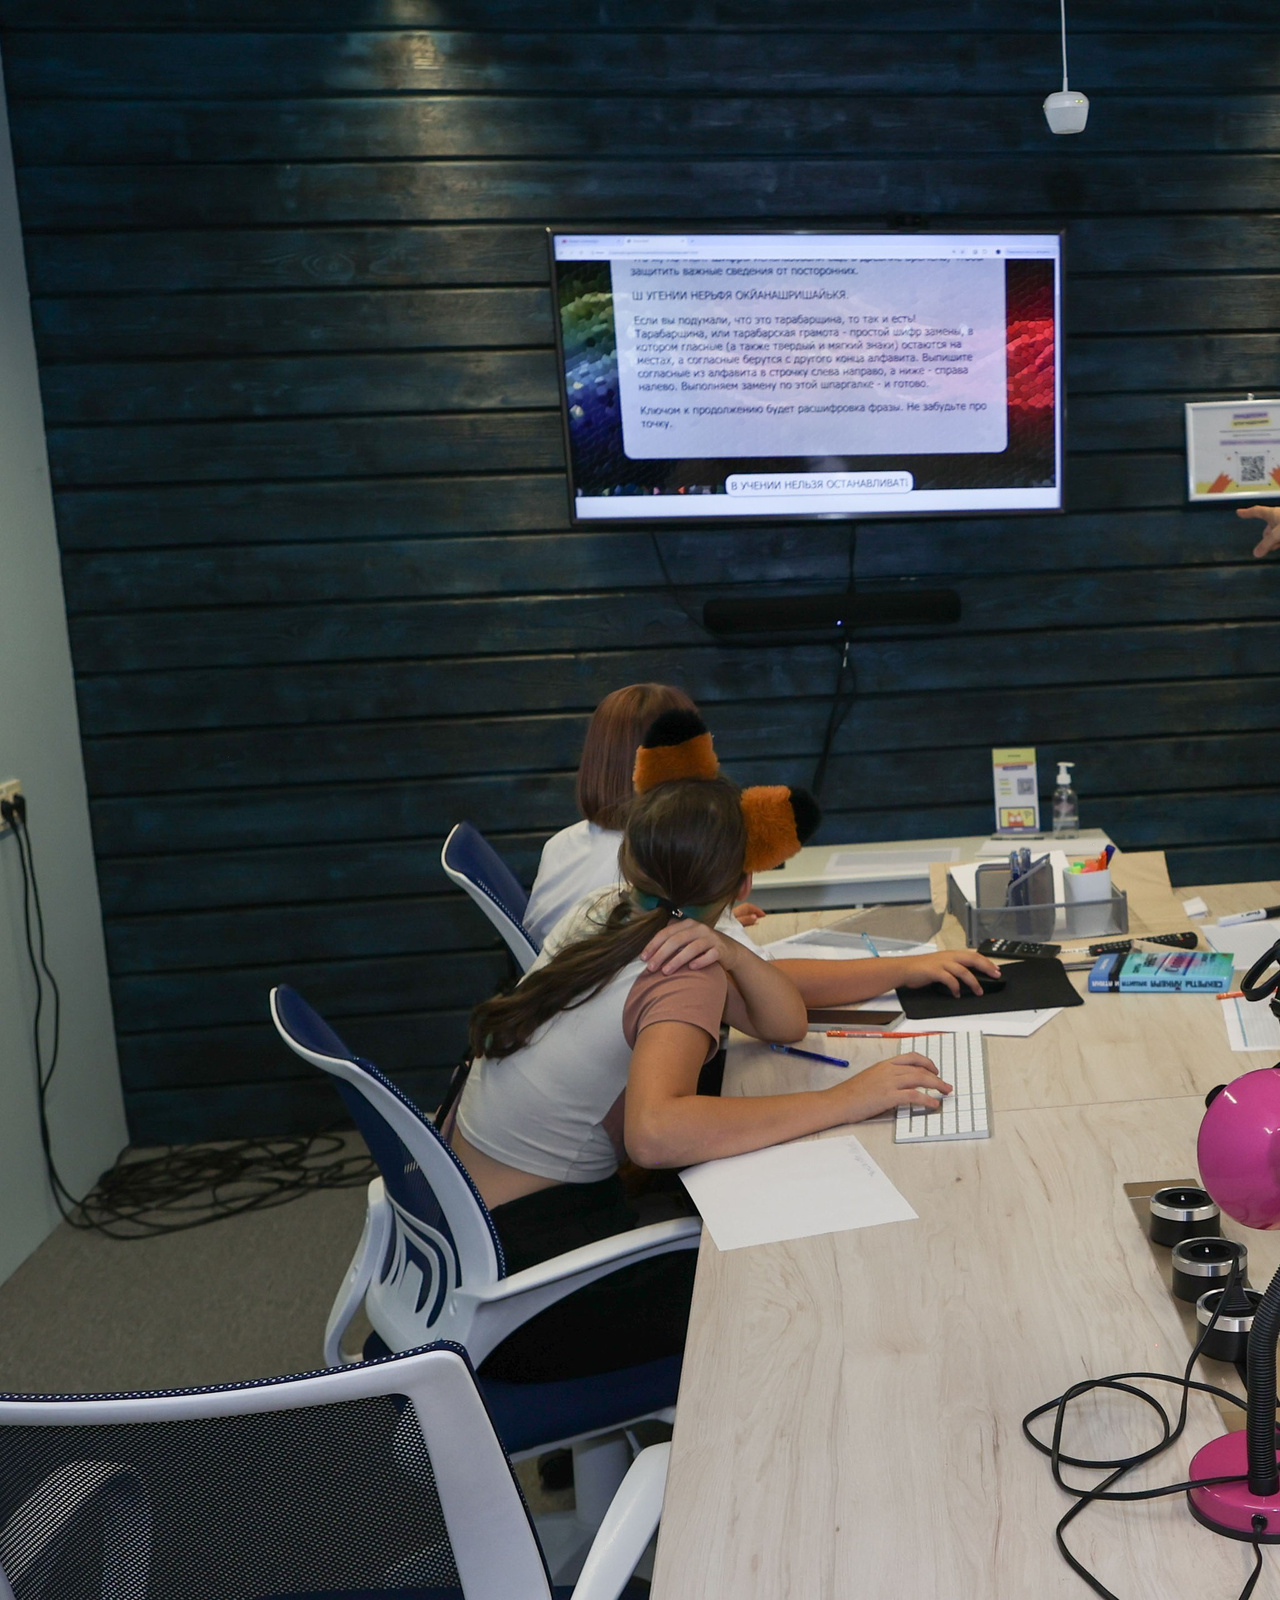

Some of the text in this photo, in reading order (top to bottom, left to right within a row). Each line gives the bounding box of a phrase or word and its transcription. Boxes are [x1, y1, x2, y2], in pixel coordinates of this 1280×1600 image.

[630, 267, 858, 278] защитить важные сведения от посторонних.
[645, 290, 688, 301] УГЕНИИ
[689, 289, 732, 301] НЕРЬФЯ
[633, 314, 658, 325] Если
[660, 316, 676, 325] вы
[677, 316, 731, 327] подумали,
[733, 316, 752, 325] что
[754, 316, 772, 324] это
[774, 313, 845, 326] тарабарщина,
[847, 315, 860, 324] то
[862, 315, 879, 324] так
[890, 312, 916, 323] есть!
[634, 328, 708, 340] Тарабарщина,
[710, 330, 730, 338] или
[732, 327, 796, 340] тарабарская
[798, 329, 840, 339] грамота
[848, 326, 890, 339] простой
[892, 326, 922, 339] шифр
[924, 328, 964, 338] замены,
[635, 343, 678, 354] котором
[680, 343, 724, 352] гласные
[739, 343, 770, 352] также
[826, 339, 863, 351] мягкий
[865, 339, 899, 352] знаки)
[900, 341, 947, 350] остаются
[949, 341, 962, 350] на
[636, 357, 675, 367] местах,
[686, 356, 740, 365] согласные
[741, 353, 783, 366] берутся
[792, 355, 833, 365] другого
[834, 355, 865, 365] конца
[866, 352, 919, 365] алфавита.
[921, 351, 973, 362] Выпишите
[636, 370, 691, 379] согласные
[692, 370, 706, 378] из
[707, 367, 758, 380] алфавита
[768, 369, 809, 379] строчку
[810, 368, 840, 377] слева
[842, 368, 887, 378] направо,
[898, 367, 925, 376] ниже
[933, 367, 968, 377] справа
[638, 383, 677, 392] налево.
[680, 380, 739, 391] Выполняем
[741, 382, 777, 392] замену
[778, 381, 793, 390] по
[794, 379, 818, 390] этой
[819, 381, 875, 391] шпаргалке
[892, 380, 928, 389] готово.
[639, 404, 681, 415] Ключом
[692, 406, 764, 416] продолжению
[764, 403, 795, 415] будет
[797, 402, 866, 415] расшифровка
[867, 401, 903, 414] фразы.
[905, 401, 921, 412] Не
[921, 400, 966, 413] забудьте
[968, 402, 987, 413] про
[641, 420, 672, 431] точку.
[739, 480, 782, 491] УЧЕНИИ
[784, 479, 824, 490] НЕЛЬЗЯ
[1185, 980, 1224, 990] СЕКРЕТЫ
